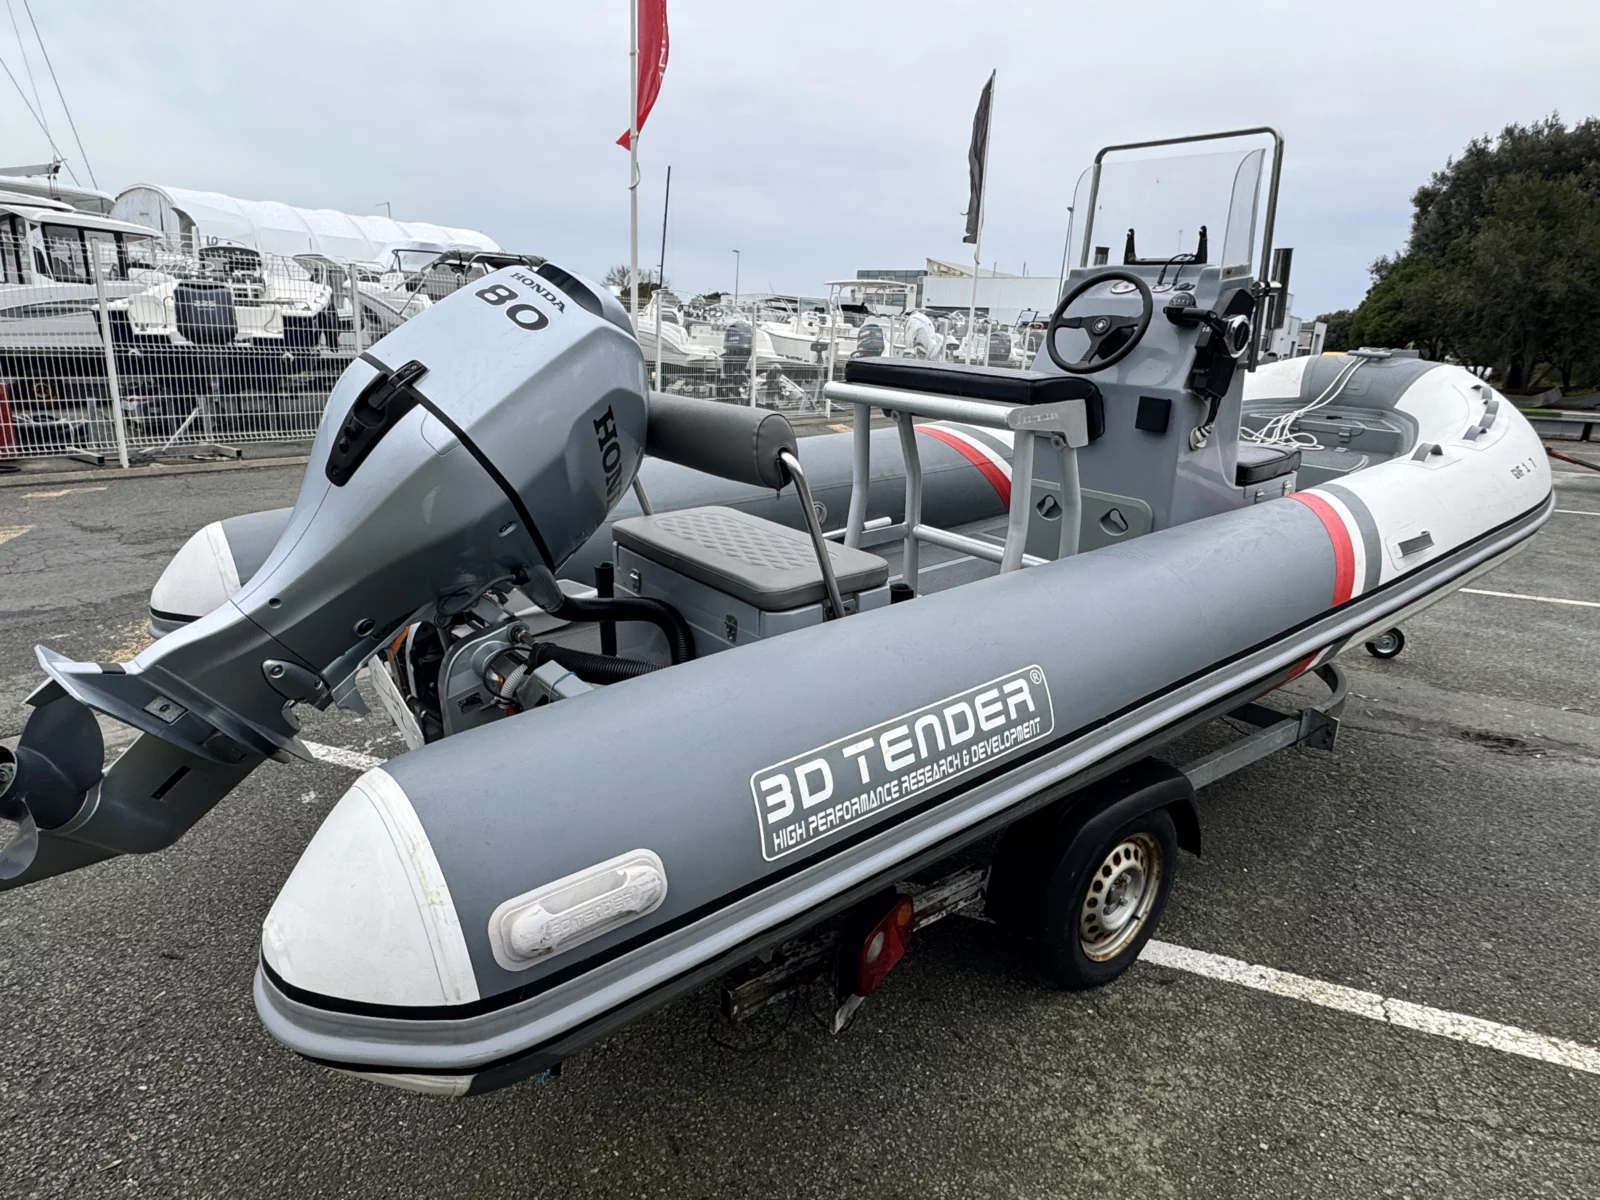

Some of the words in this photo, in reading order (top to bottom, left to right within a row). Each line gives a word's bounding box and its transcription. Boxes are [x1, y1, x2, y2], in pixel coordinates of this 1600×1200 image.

[474, 284, 550, 331] 80
[509, 272, 566, 314] HONDA
[759, 757, 834, 825] 3D
[773, 821, 805, 852] HIGH
[808, 779, 900, 840] PERFORMANCE
[901, 753, 961, 794] RESEARCH
[962, 749, 970, 767] &
[971, 717, 1042, 763] DEVELOPMENT
